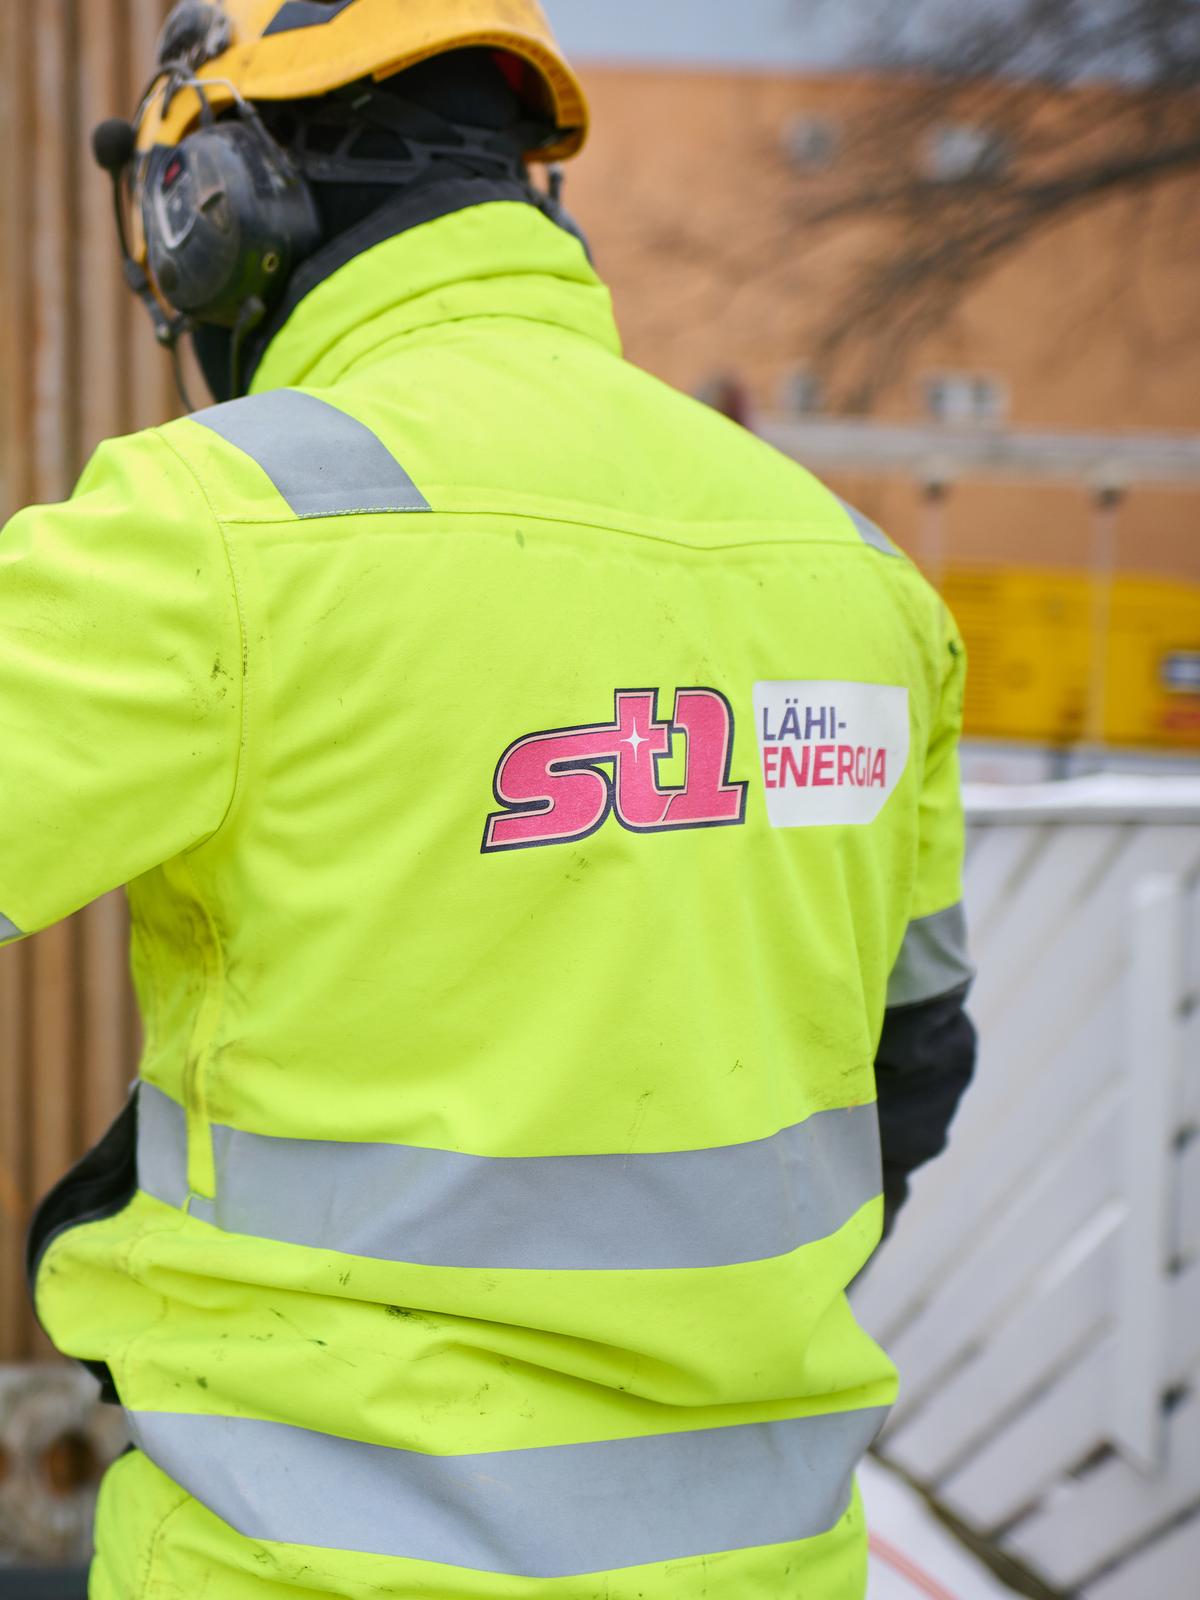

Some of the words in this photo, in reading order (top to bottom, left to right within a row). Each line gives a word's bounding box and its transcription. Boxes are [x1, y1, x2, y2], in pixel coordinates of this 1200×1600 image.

[763, 698, 847, 741] LÄHI-
[480, 686, 749, 854] st1
[763, 744, 887, 788] ENERGIA
